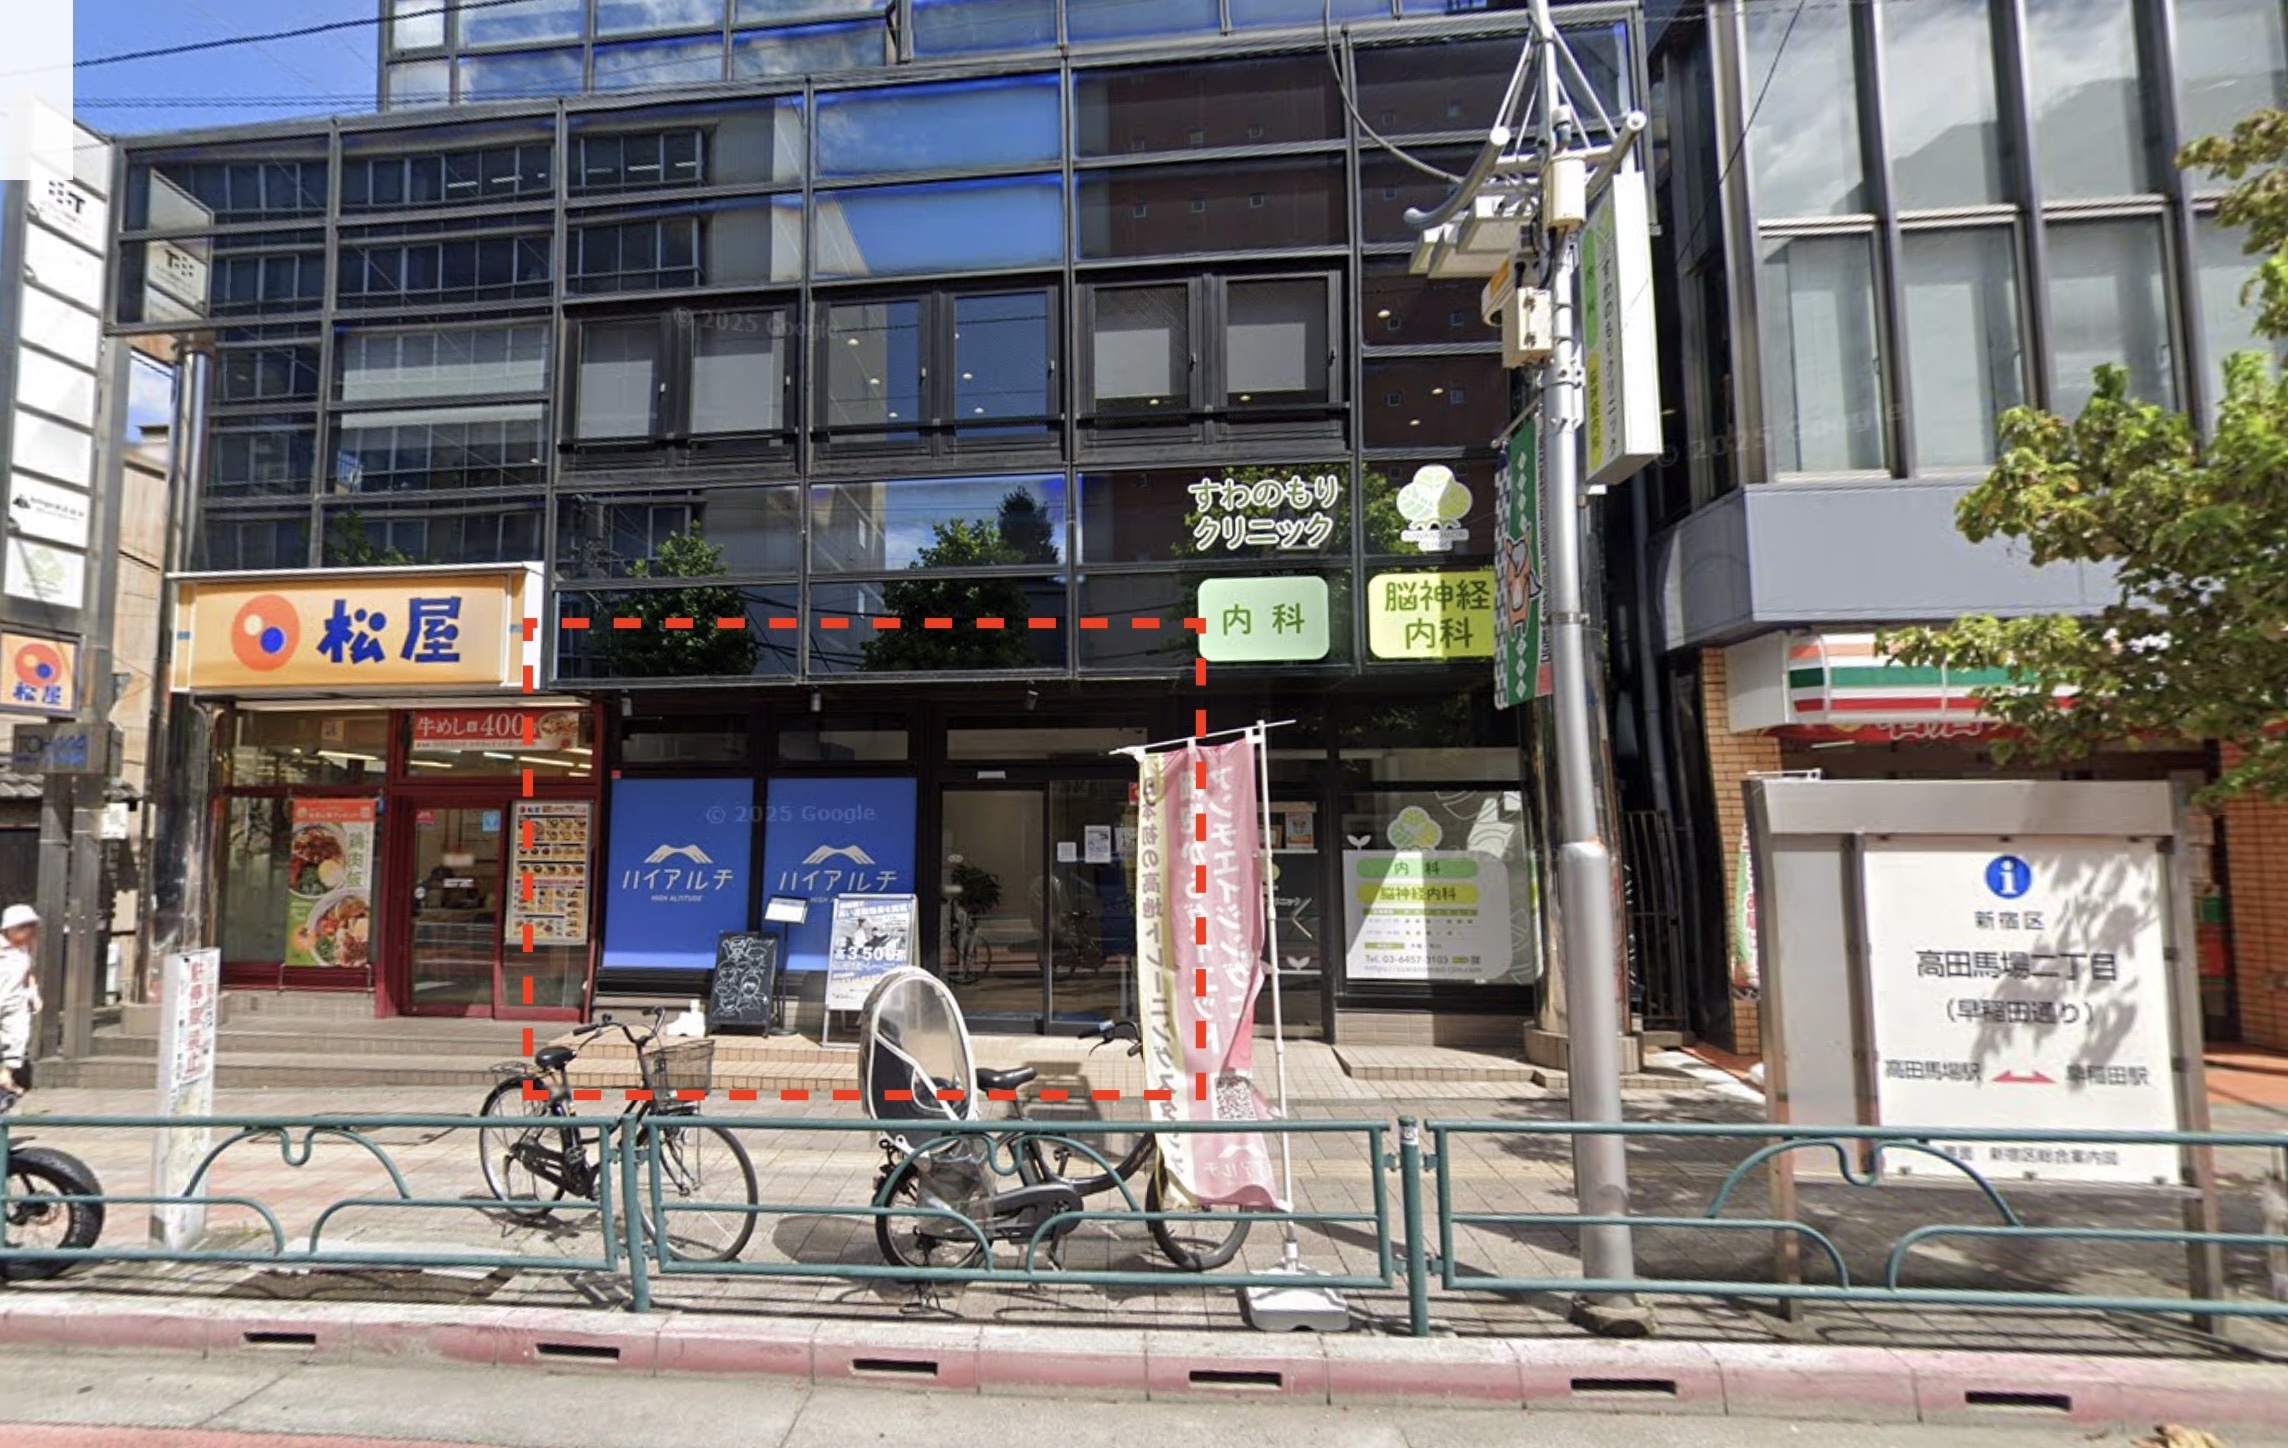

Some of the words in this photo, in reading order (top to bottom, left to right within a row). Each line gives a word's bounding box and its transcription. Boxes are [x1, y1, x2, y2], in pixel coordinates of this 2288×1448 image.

[1188, 474, 1339, 510] すわのもり
[1194, 513, 1335, 552] クリニック
[1383, 580, 1491, 613] 脳神経
[317, 595, 463, 665] 松屋
[1221, 602, 1306, 636] 内科
[1404, 617, 1475, 650] 内科
[12, 682, 62, 705] 松屋
[622, 868, 734, 891] ハイアルチ
[1394, 860, 1440, 876] 内科
[779, 870, 898, 892] ハイアルチ
[1379, 886, 1457, 901] 脳神経内科
[1974, 910, 2045, 931] 新宿区
[1915, 950, 2118, 981] 高田馬場二丁目
[1885, 1059, 1983, 1083] 高田馬場駅
[2066, 1064, 2150, 1086] 早稲田駅
